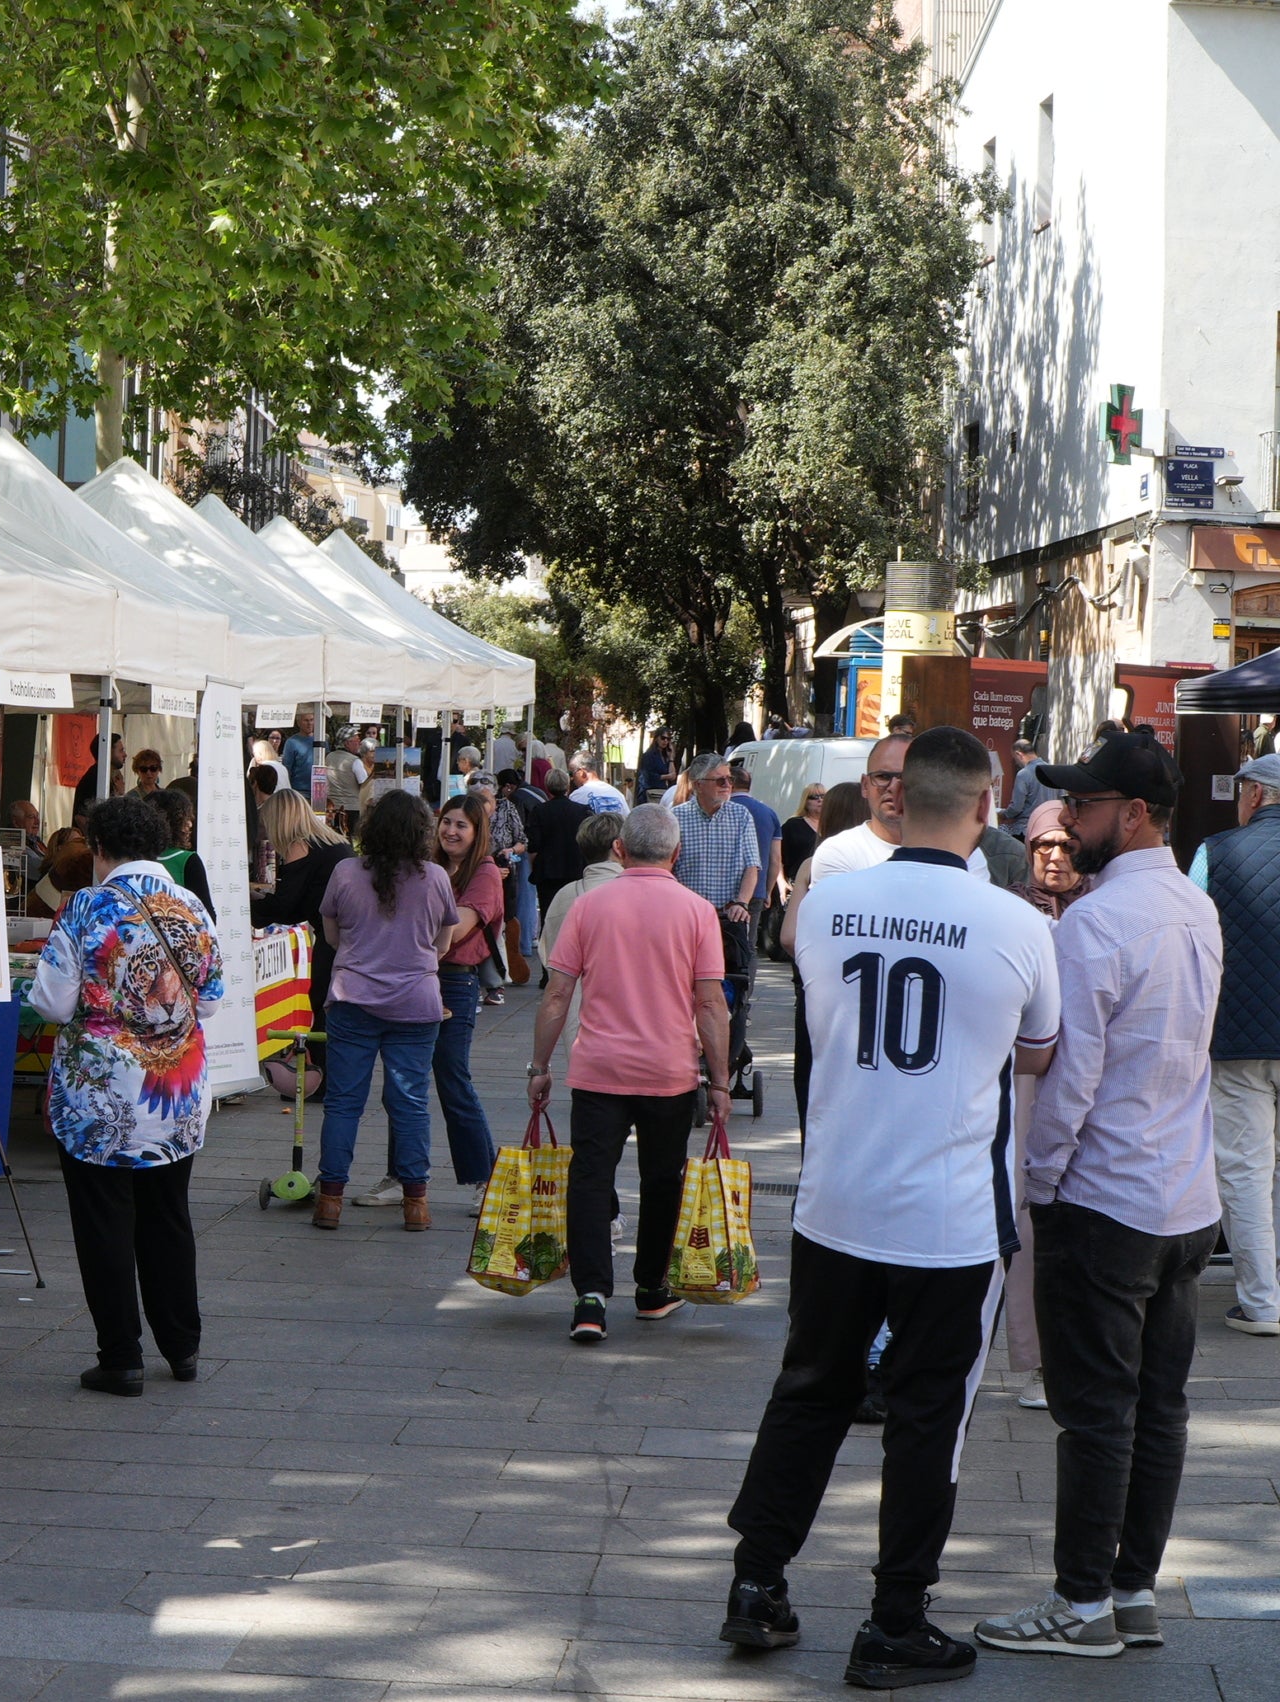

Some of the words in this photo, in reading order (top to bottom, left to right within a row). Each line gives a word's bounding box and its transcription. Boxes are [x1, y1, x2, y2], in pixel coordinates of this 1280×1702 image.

[973, 690, 989, 702] Cada
[1003, 693, 1024, 703] encesa
[973, 702, 981, 713] és
[981, 705, 990, 713] un
[990, 705, 1012, 716] comerç
[972, 716, 988, 729] que
[988, 715, 1014, 731] batega
[831, 914, 968, 949] BELLINGHAM
[842, 951, 946, 1075] 10
[739, 1583, 759, 1593] FILA
[928, 1635, 942, 1647] FILA
